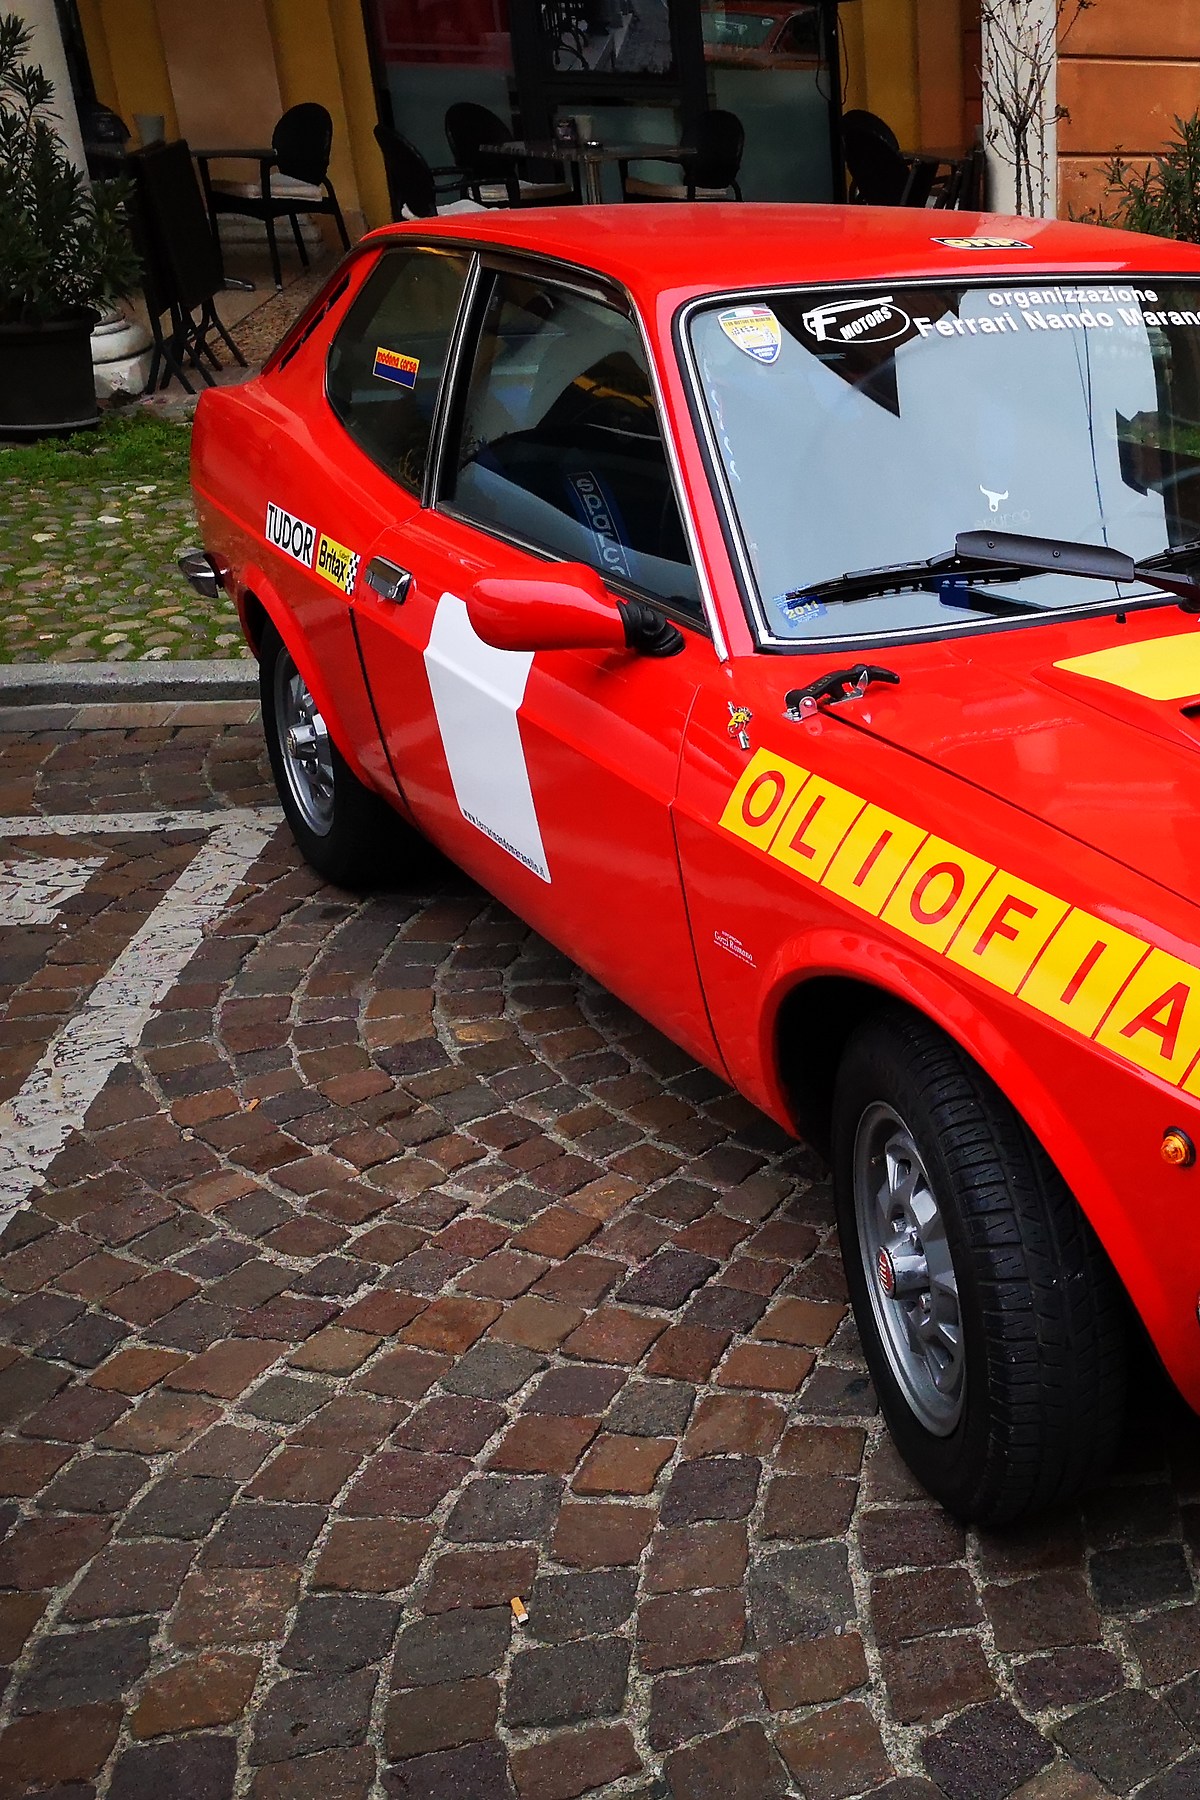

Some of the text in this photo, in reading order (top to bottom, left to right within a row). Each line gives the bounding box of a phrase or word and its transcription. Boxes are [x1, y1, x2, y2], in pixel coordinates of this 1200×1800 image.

[988, 285, 1159, 308] organizzazione
[839, 306, 893, 341] MOTORS
[912, 311, 1018, 339] Ferrari
[1024, 309, 1114, 333] Nando
[268, 504, 315, 567] TUDOR
[318, 539, 348, 583] Britax
